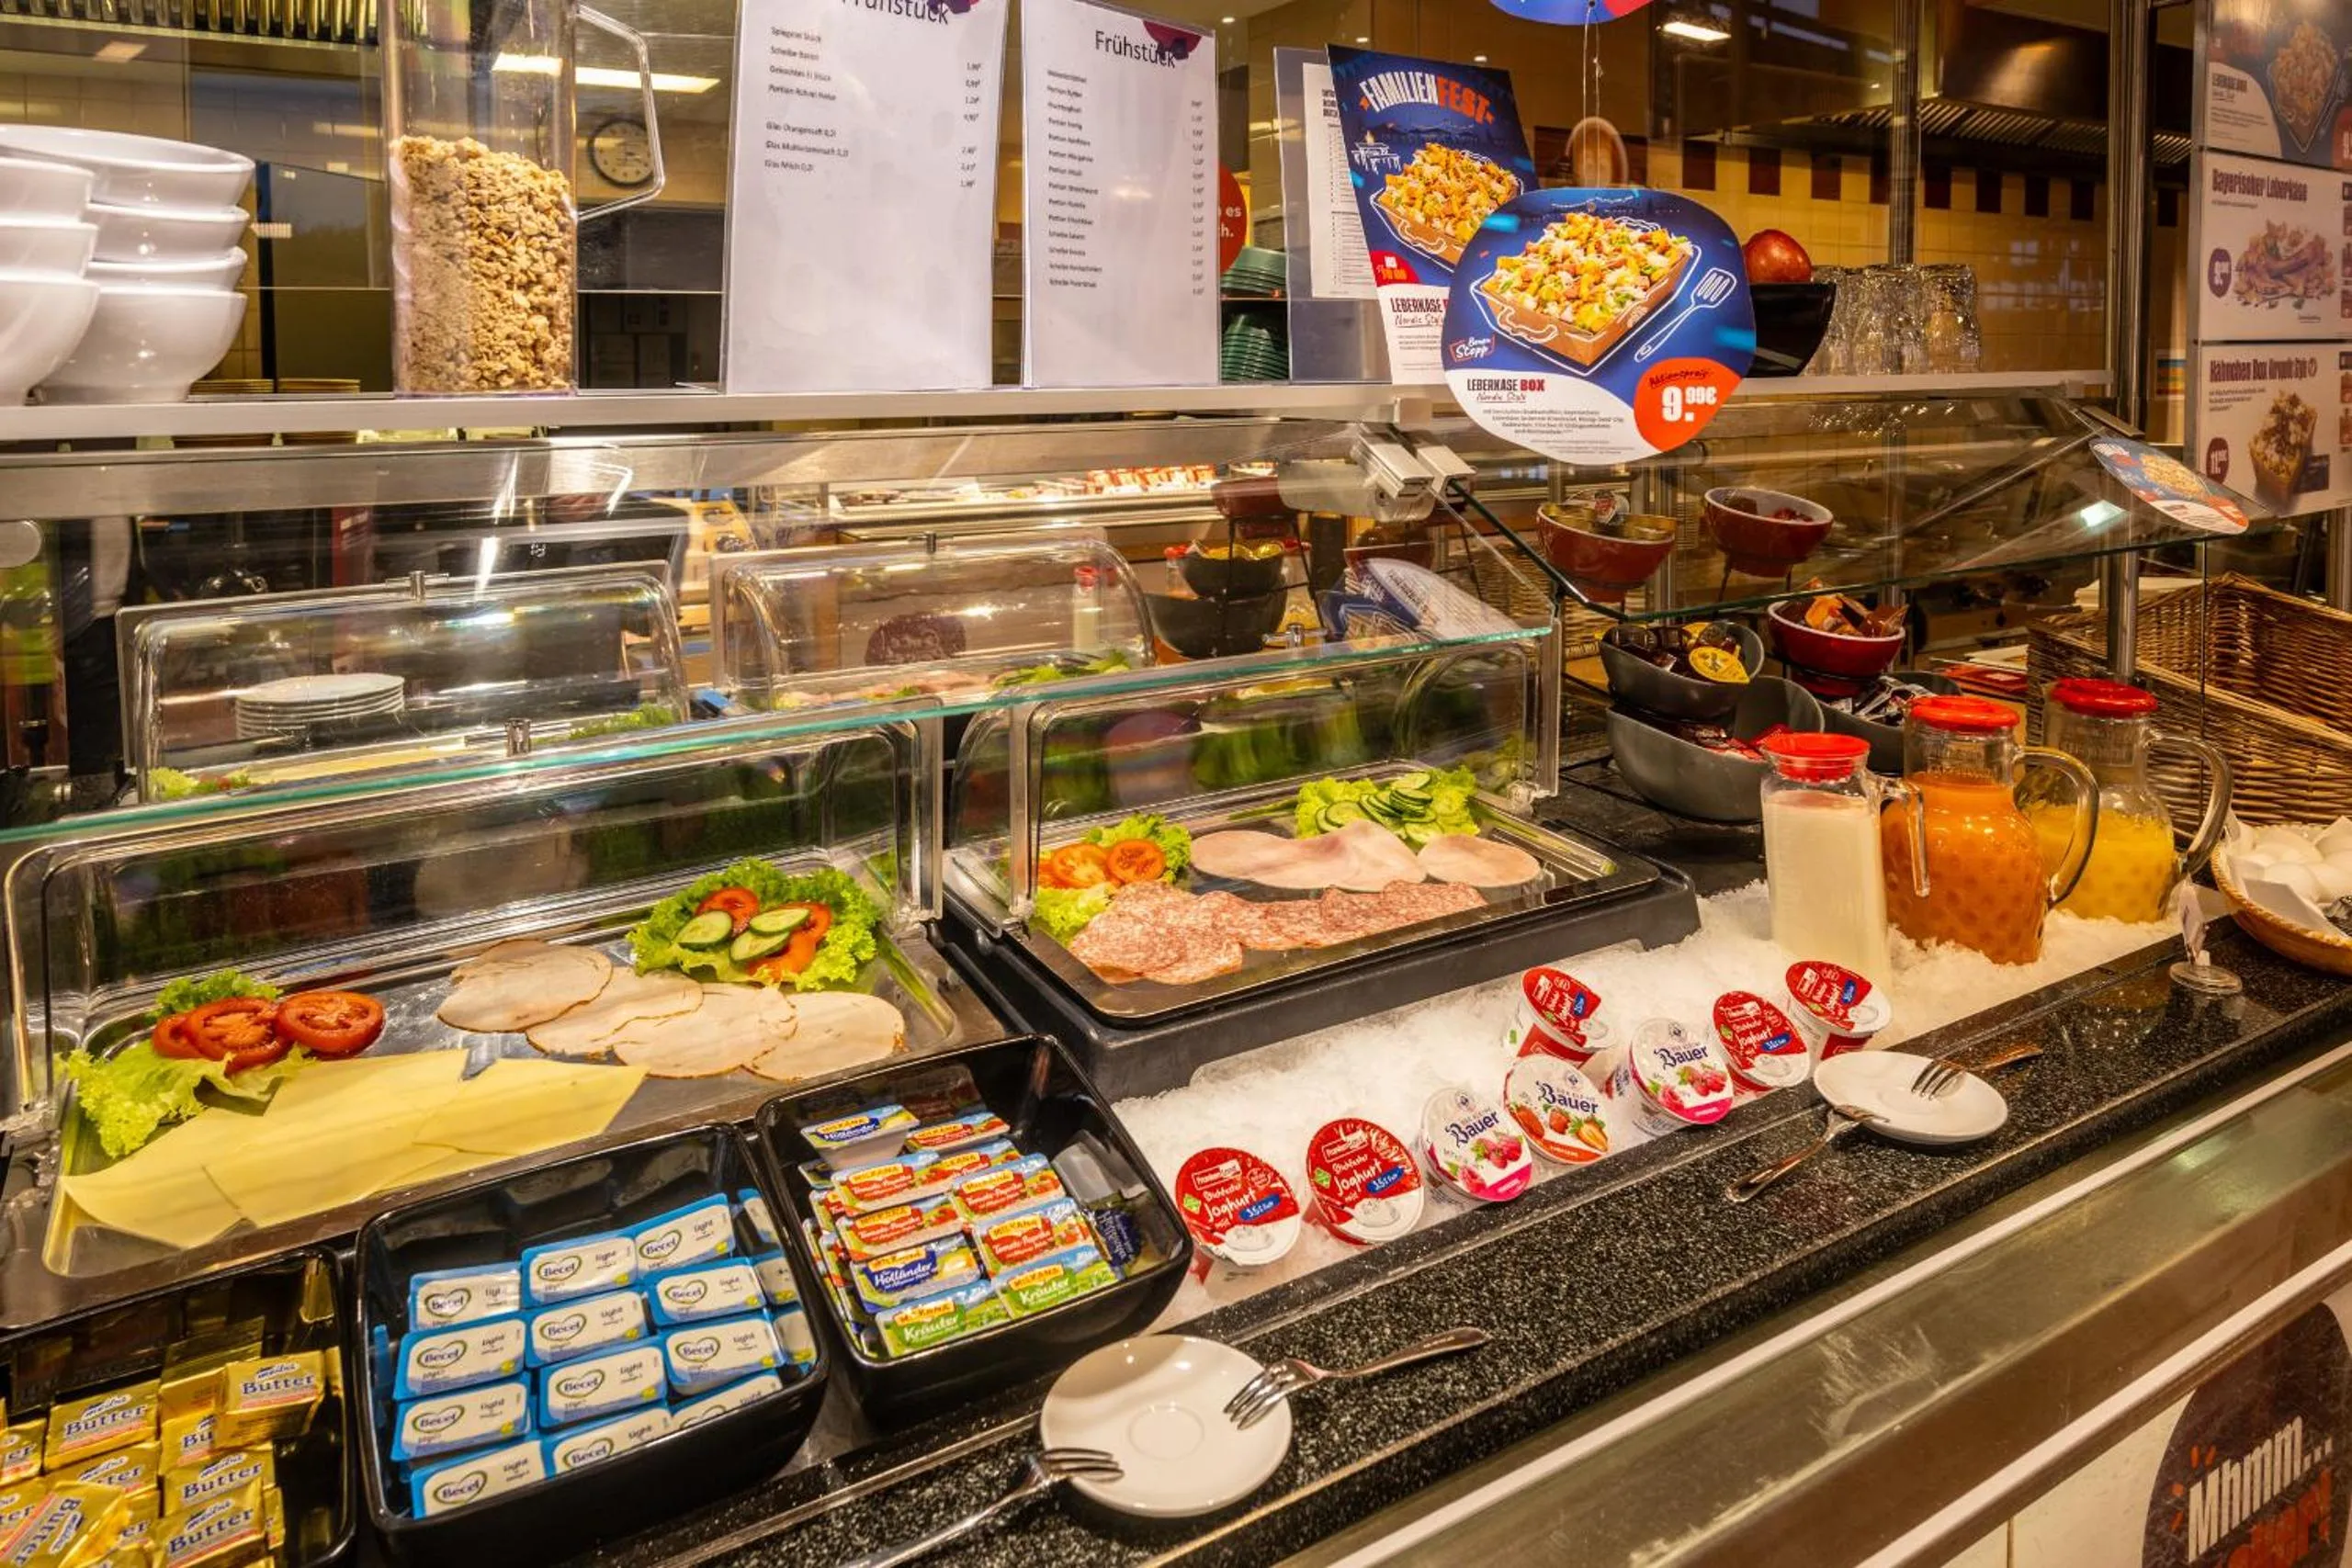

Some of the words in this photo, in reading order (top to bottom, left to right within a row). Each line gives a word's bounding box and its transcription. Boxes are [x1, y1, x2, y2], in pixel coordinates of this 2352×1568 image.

[1095, 29, 1175, 69] Frühstück
[1520, 378, 1544, 391] BOX
[1654, 1045, 1708, 1070] Bauer
[1535, 1080, 1599, 1113] Bauer
[1445, 1111, 1499, 1148] Bauer
[1333, 1158, 1383, 1197] Joghurt
[1204, 1187, 1256, 1223] Joghurt
[243, 1375, 314, 1394] Butter
[65, 1404, 147, 1435] Butter
[184, 1463, 262, 1498] Butter
[16, 1499, 81, 1564] Butter
[169, 1508, 252, 1552] Butter
